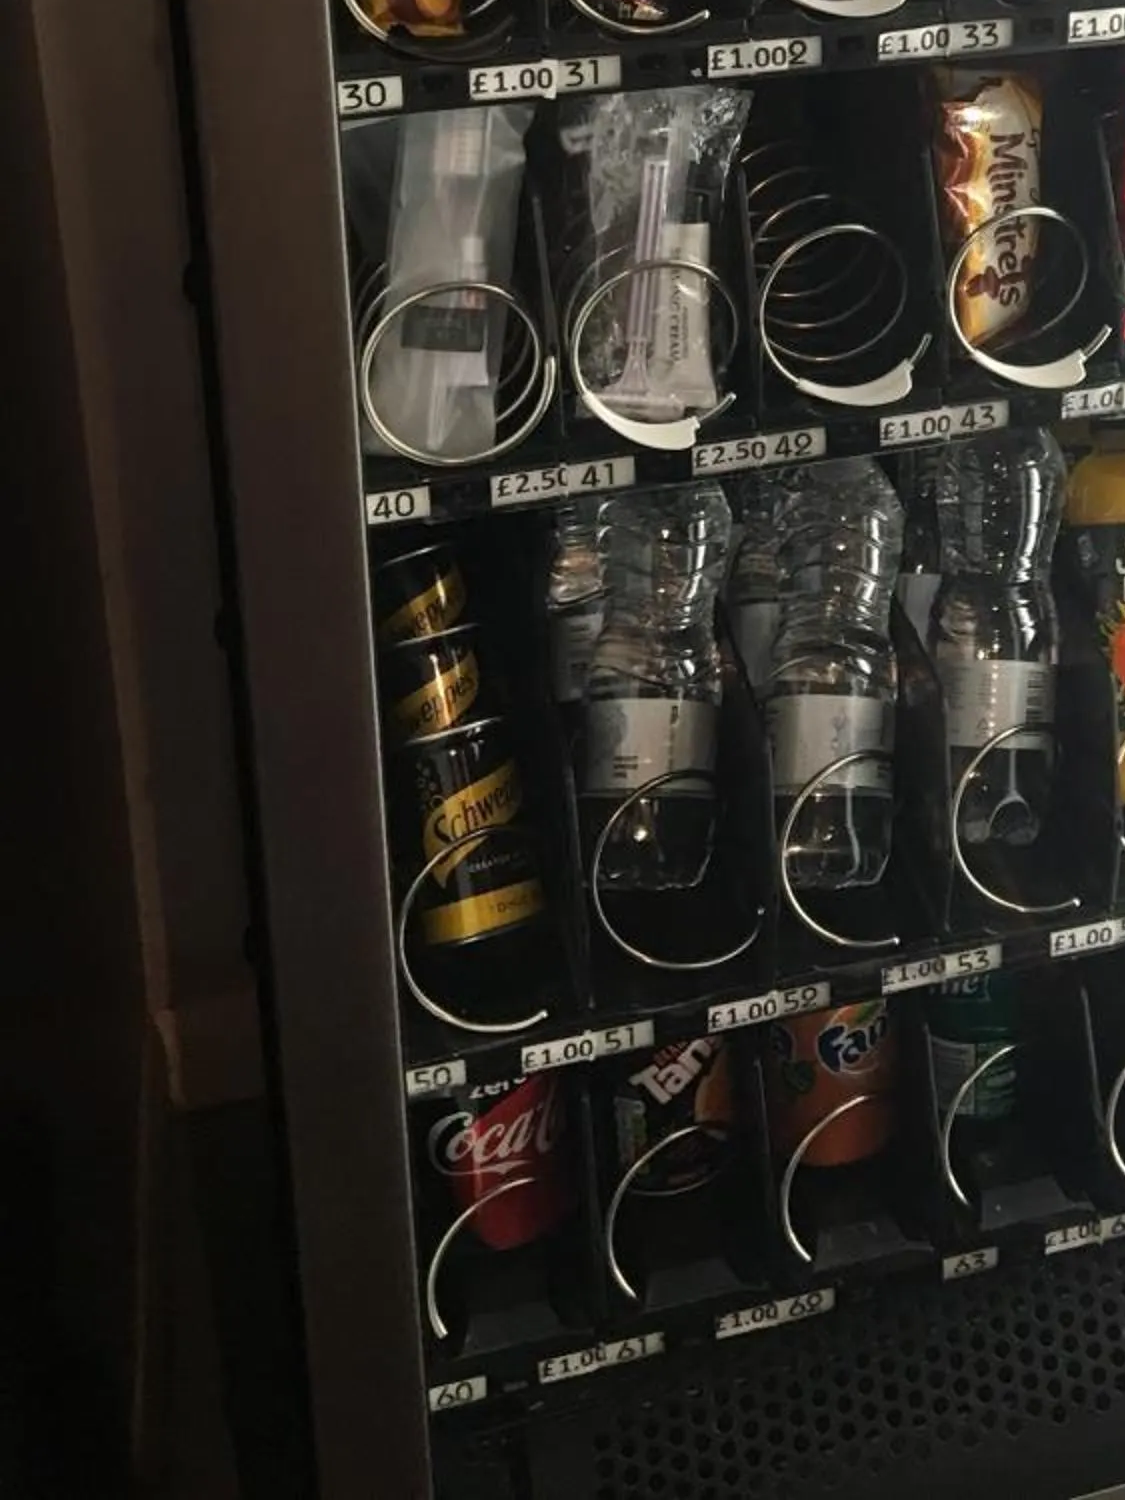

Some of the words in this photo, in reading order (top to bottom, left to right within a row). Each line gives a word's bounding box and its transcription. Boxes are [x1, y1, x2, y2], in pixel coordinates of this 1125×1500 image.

[879, 27, 950, 55] £1.00
[961, 23, 999, 48] 33
[472, 66, 553, 94] £1.00
[565, 59, 600, 87] 31
[341, 82, 386, 109] 30
[988, 131, 1028, 307] Minstrels
[882, 416, 951, 441] £1.00
[961, 405, 995, 428] 43
[695, 442, 767, 469] £2.50
[774, 433, 812, 458] 42
[581, 462, 616, 488] 41
[372, 493, 415, 518] 40
[1054, 927, 1113, 953] £1.00
[881, 957, 947, 987] £1.00
[957, 949, 991, 974] 53
[710, 999, 778, 1030] £1.00
[783, 986, 820, 1012] 52
[524, 1038, 594, 1070] £1.00
[604, 1026, 637, 1051] 51
[816, 1014, 888, 1073] Fan
[413, 1066, 452, 1090] 50
[628, 1034, 717, 1106] Tan
[1046, 1220, 1102, 1247] £1.00
[952, 1252, 988, 1274] 63
[717, 1301, 778, 1333] £1.00
[787, 1292, 824, 1318] 62
[542, 1344, 607, 1380] £1.00
[617, 1336, 649, 1361] 61
[437, 1380, 474, 1409] 60
